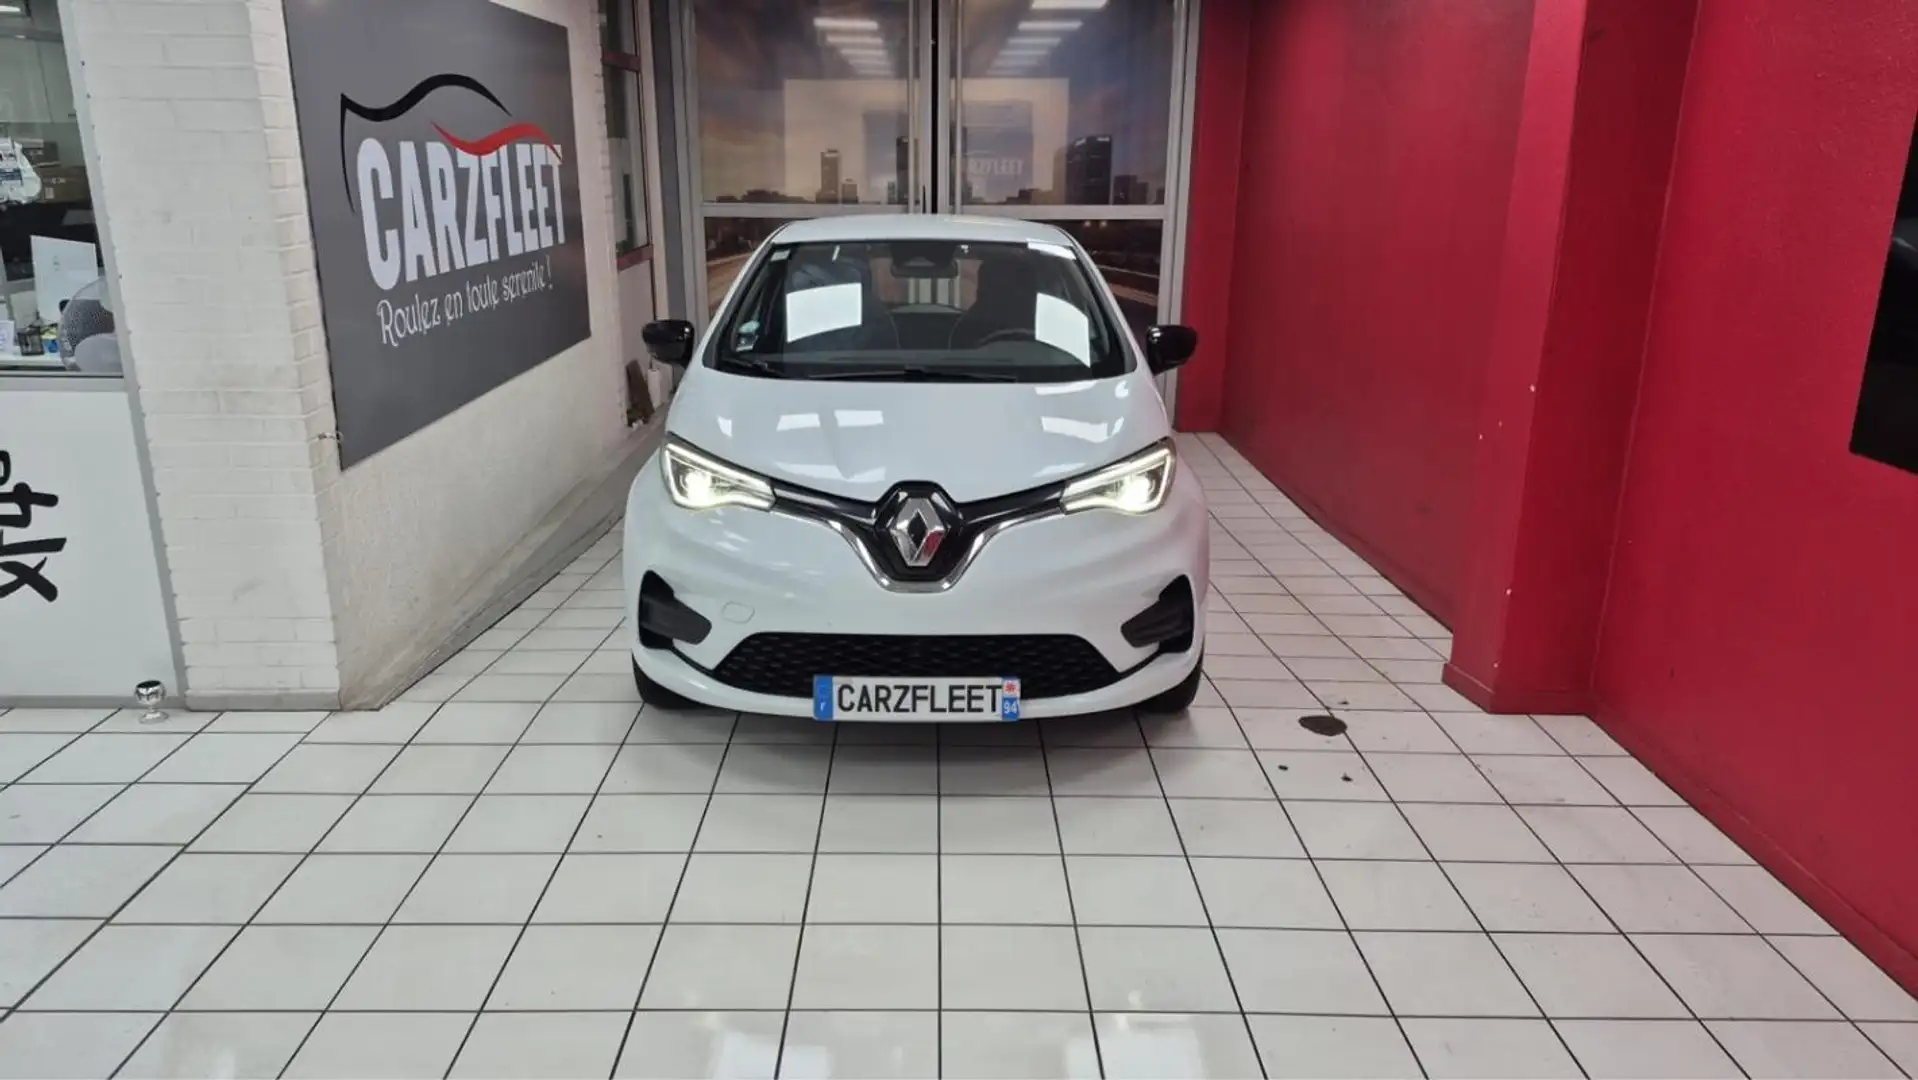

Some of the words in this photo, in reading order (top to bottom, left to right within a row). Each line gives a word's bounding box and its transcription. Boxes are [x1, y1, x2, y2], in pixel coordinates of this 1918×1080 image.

[357, 137, 565, 290] CARZFLEET
[376, 293, 441, 347] Roulez
[444, 291, 464, 326] en
[465, 275, 500, 313] toute
[837, 684, 1002, 713] CARZFLEET
[1003, 700, 1018, 714] 94
